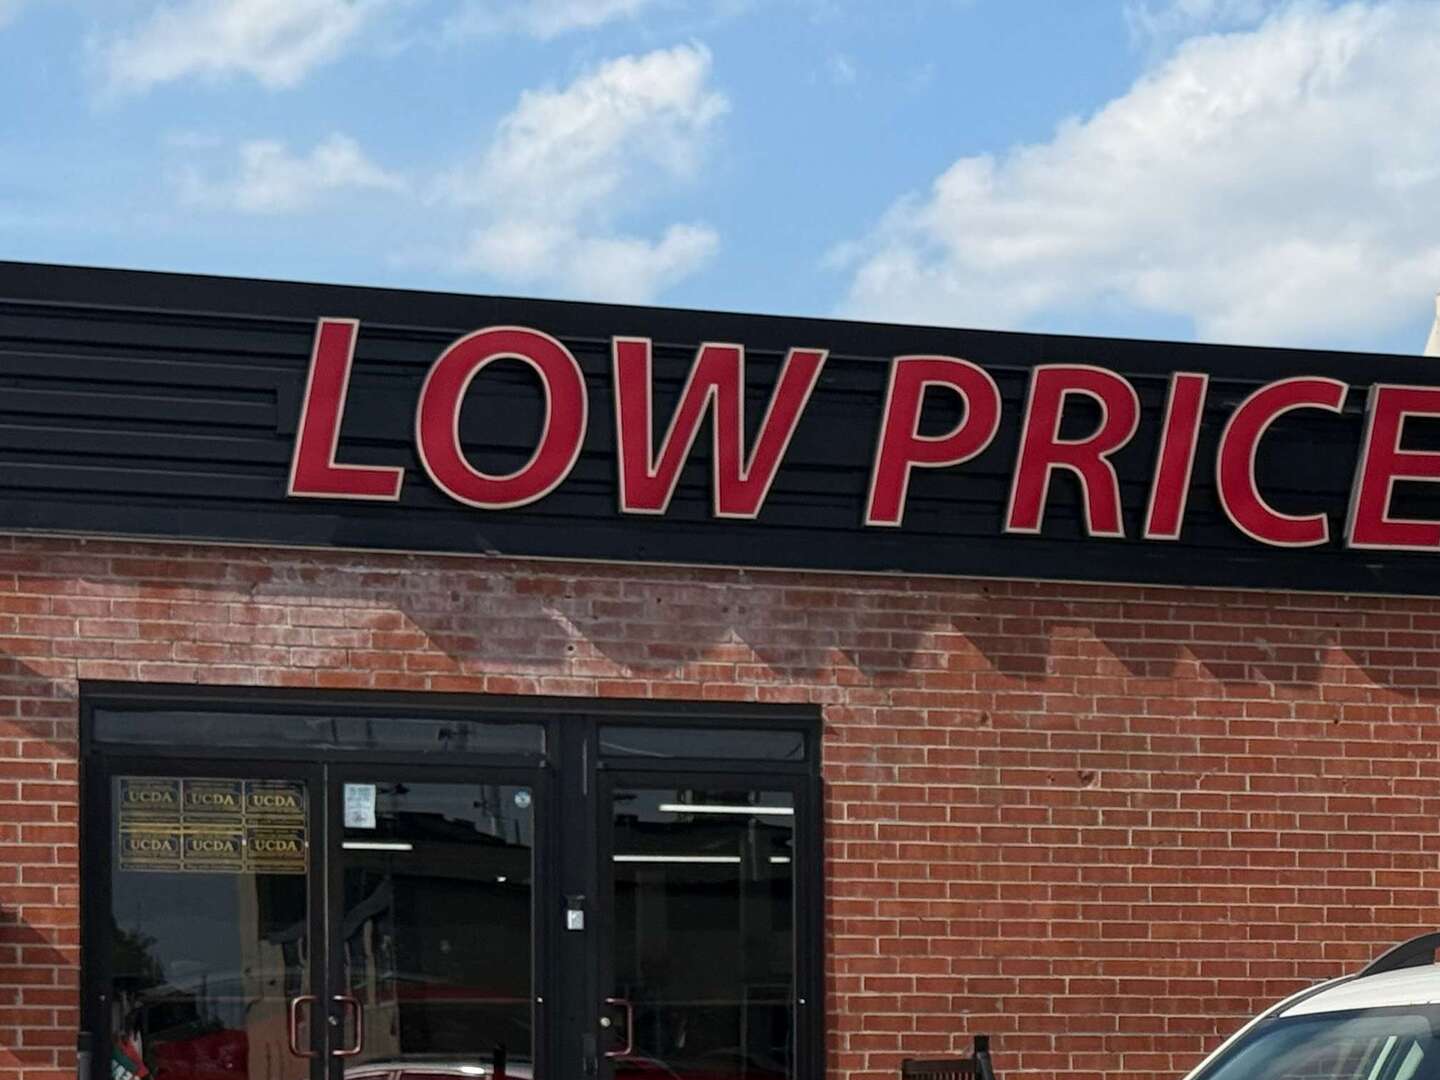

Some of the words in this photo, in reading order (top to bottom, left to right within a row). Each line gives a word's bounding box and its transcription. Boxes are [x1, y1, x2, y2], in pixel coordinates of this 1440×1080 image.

[287, 316, 830, 519] LOW
[129, 791, 173, 803] UCDA
[192, 793, 235, 806] UCDA
[253, 795, 296, 807] UCDA
[130, 839, 173, 851] UCDA
[192, 840, 234, 852] UCDA
[254, 840, 297, 852] UCDA
